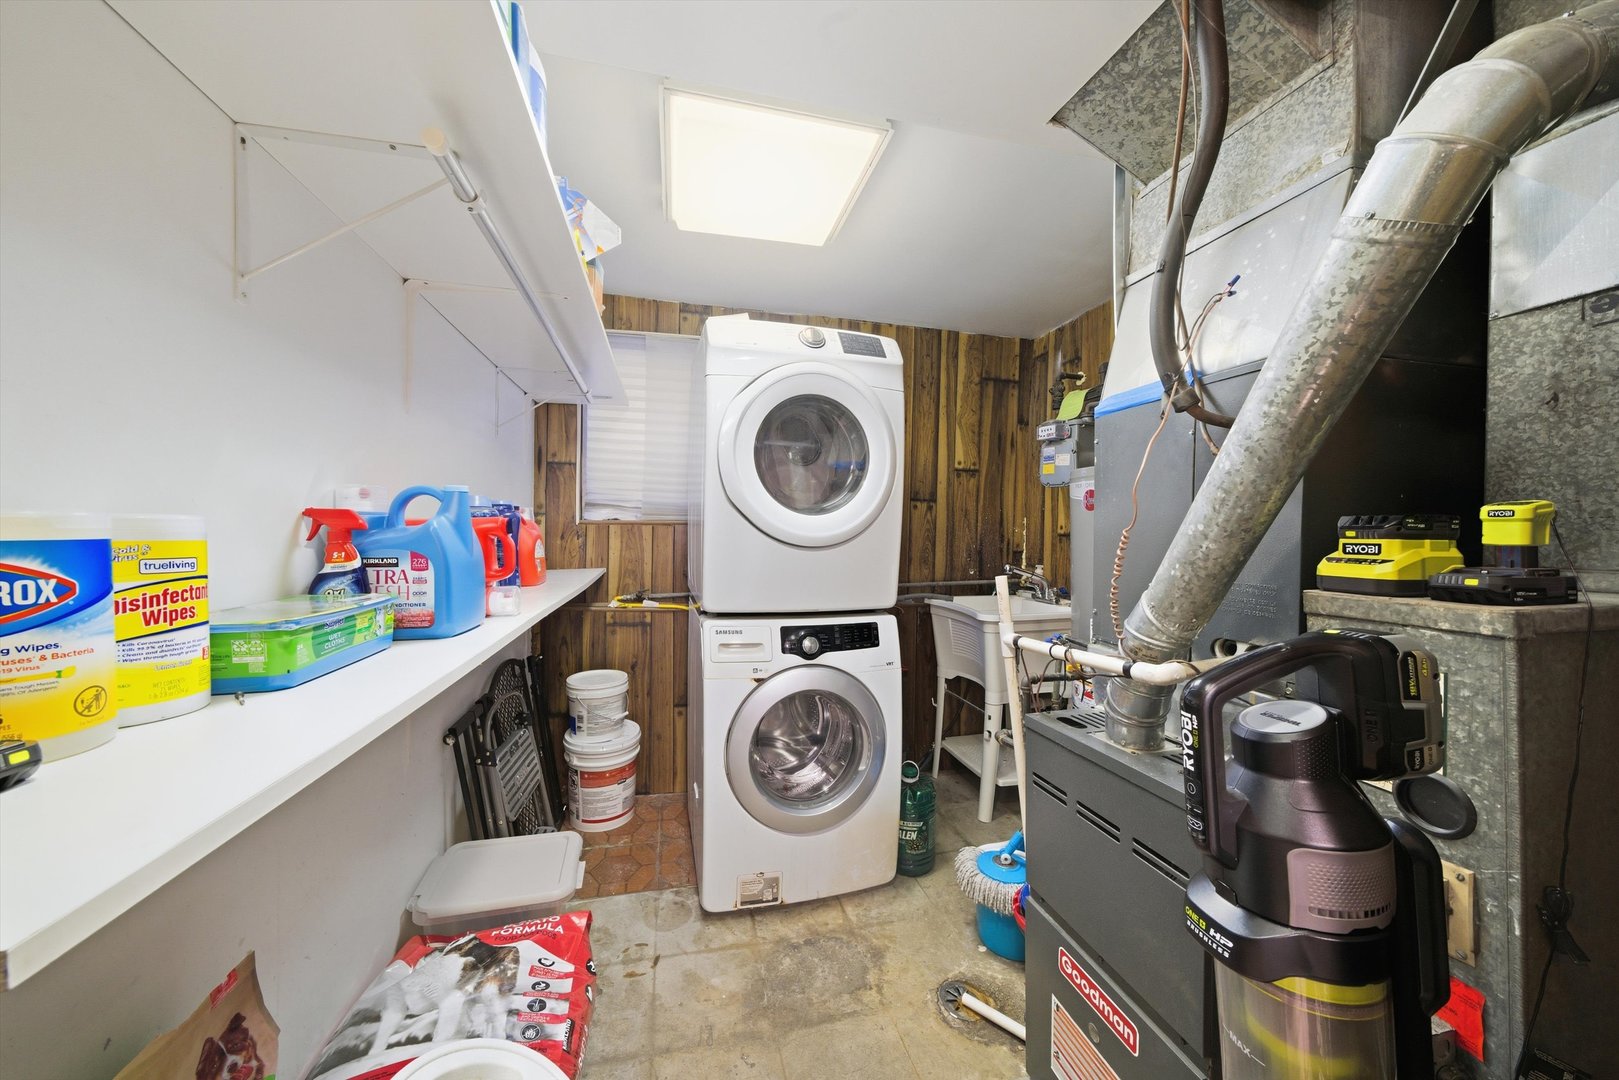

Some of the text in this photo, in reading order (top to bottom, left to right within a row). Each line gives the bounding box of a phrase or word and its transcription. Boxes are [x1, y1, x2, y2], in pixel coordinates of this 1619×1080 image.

[1345, 544, 1379, 554] RYOBI
[143, 560, 196, 571] trueliving
[370, 569, 410, 585] TRA
[141, 605, 196, 627] Wipes
[15, 642, 60, 653] Wipes
[39, 652, 47, 662] &
[51, 648, 95, 660] Bacteria
[15, 665, 40, 673] Virus
[1180, 710, 1195, 771] RYOBI
[491, 922, 564, 937] FORMULA
[1209, 927, 1234, 948] HP
[1187, 919, 1230, 958] BRUSHLESS
[1061, 955, 1134, 1046] Goodman
[1229, 1030, 1251, 1059] MAX
